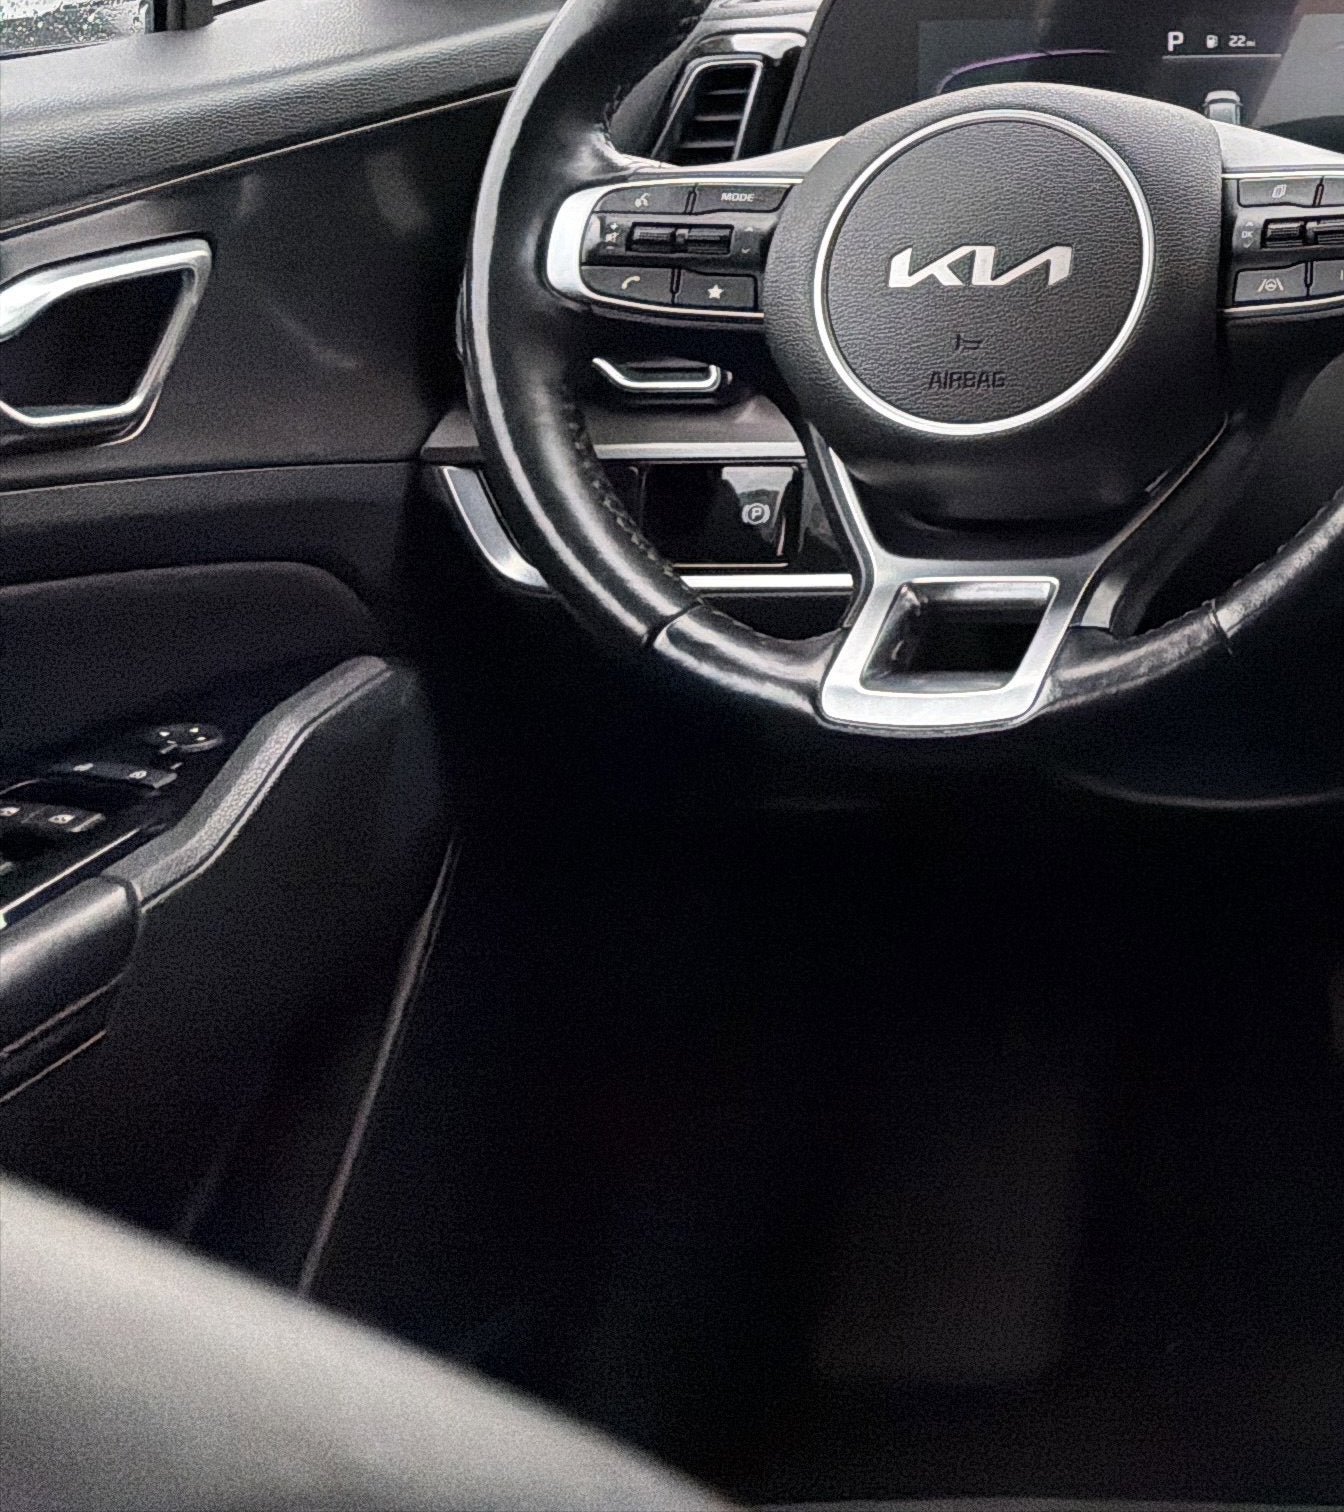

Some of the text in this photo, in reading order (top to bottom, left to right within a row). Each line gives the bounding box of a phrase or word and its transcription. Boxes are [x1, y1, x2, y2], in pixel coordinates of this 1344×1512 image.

[1167, 31, 1184, 51] P
[720, 191, 756, 204] MODE
[928, 370, 1006, 390] AIRBAG
